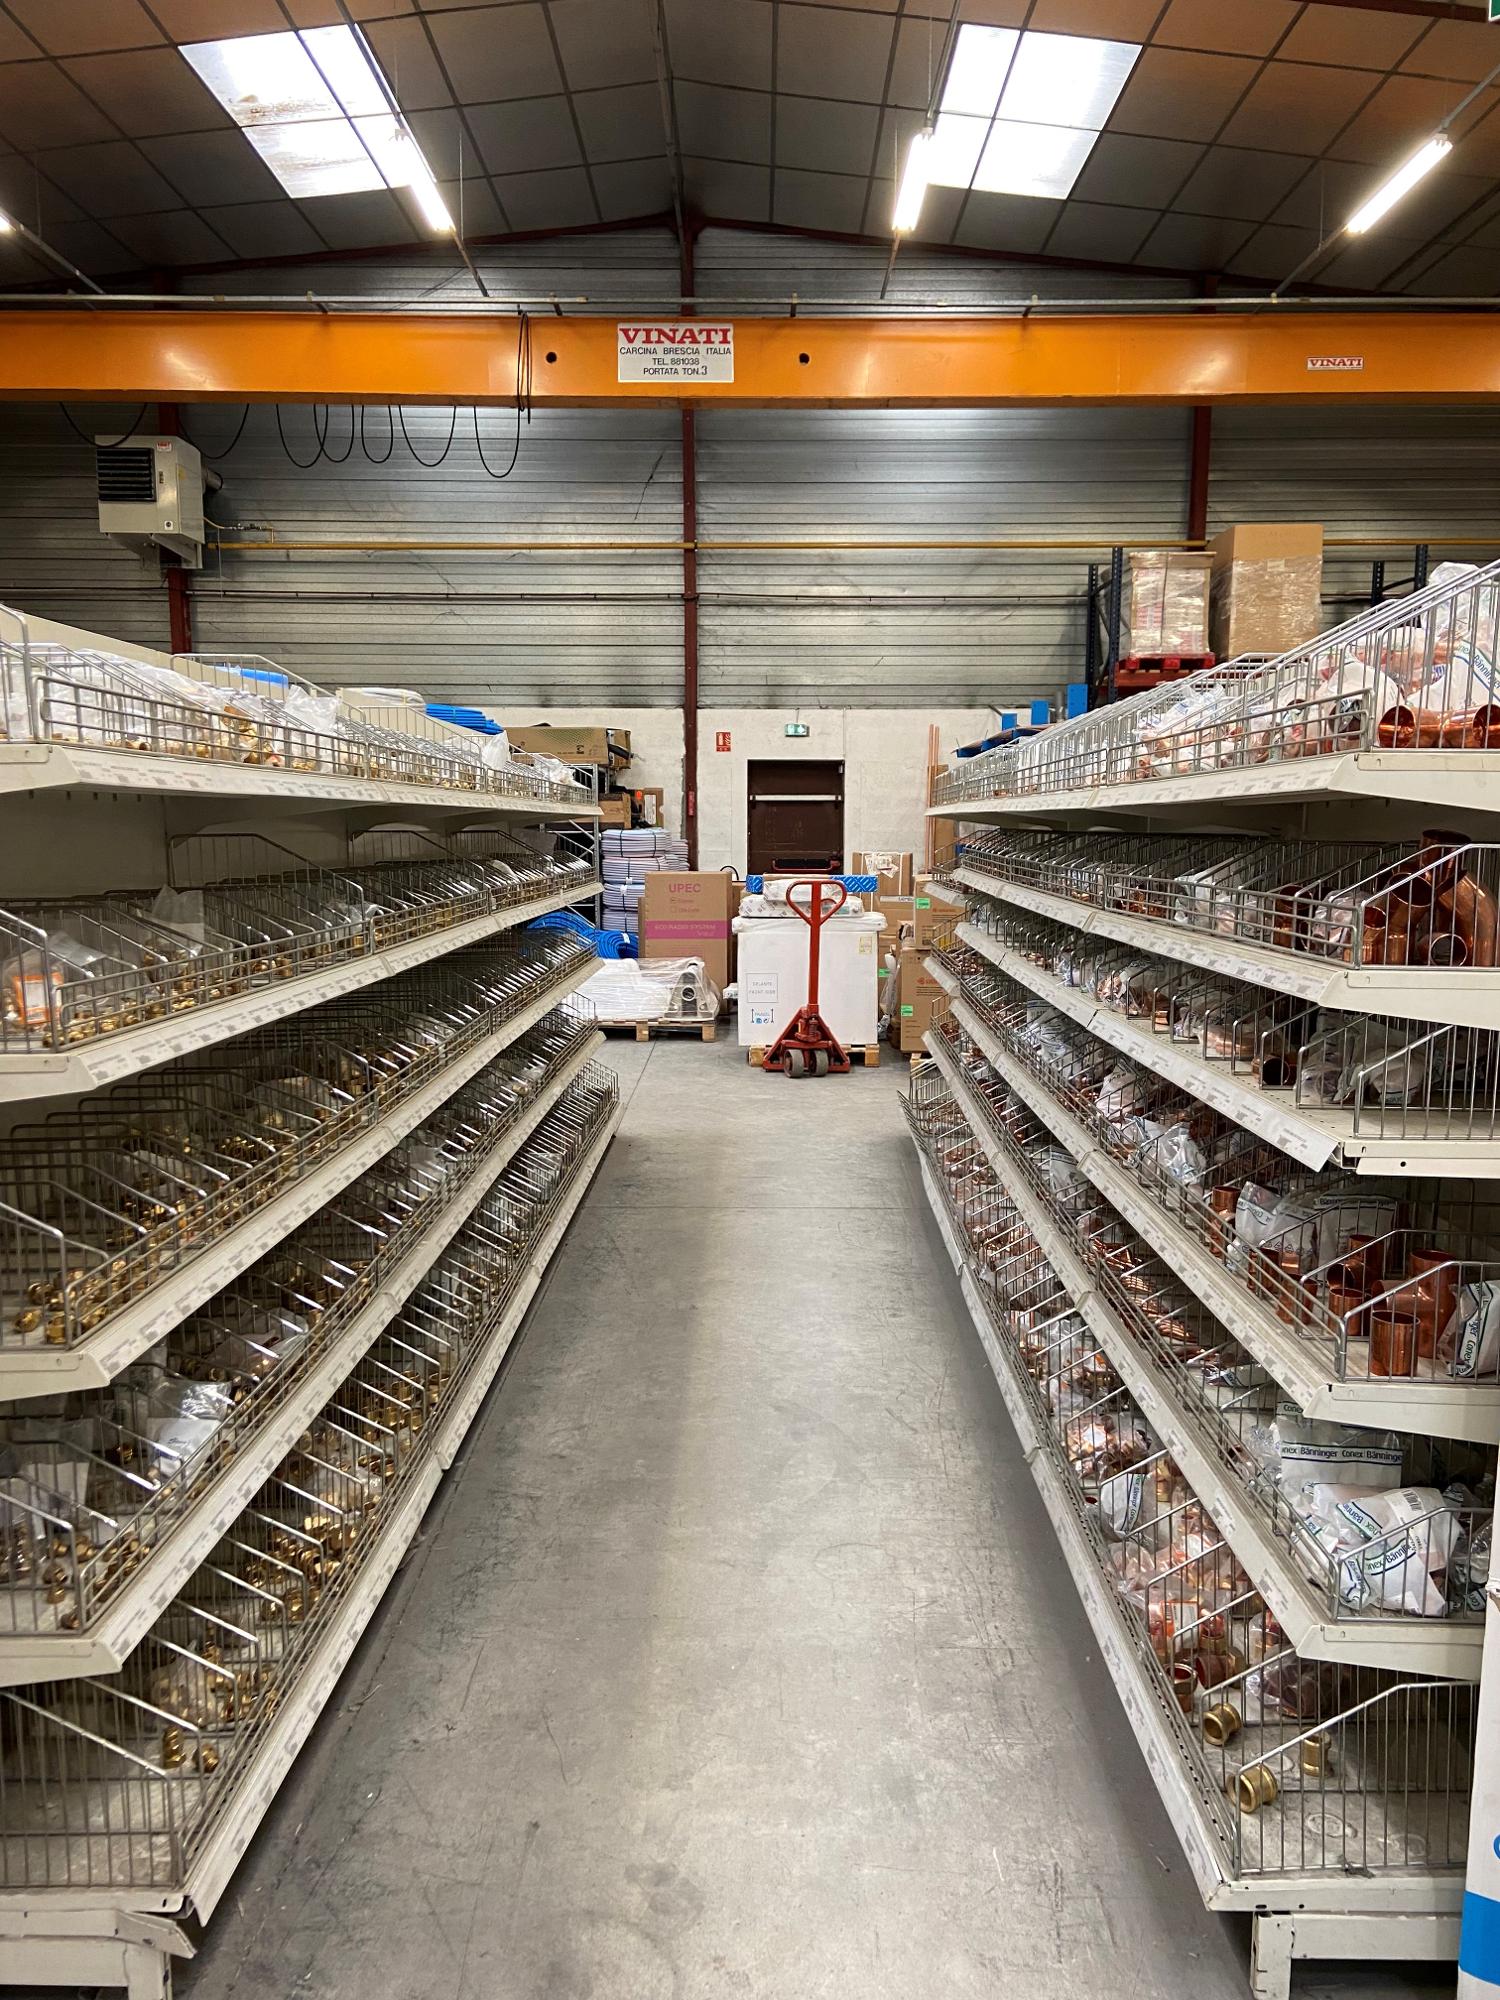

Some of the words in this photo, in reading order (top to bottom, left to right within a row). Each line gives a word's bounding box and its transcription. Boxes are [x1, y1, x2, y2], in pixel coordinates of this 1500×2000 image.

[619, 328, 731, 344] VINATI
[619, 347, 658, 355] CARCINA
[663, 347, 700, 355] BRESCIA
[706, 347, 732, 355] ITALIA
[1309, 358, 1362, 367] VINATI
[643, 367, 679, 375] PORTATA
[668, 883, 702, 893] UPEC
[1300, 1446, 1338, 1459] Bänninger
[1341, 1449, 1364, 1458] Conex
